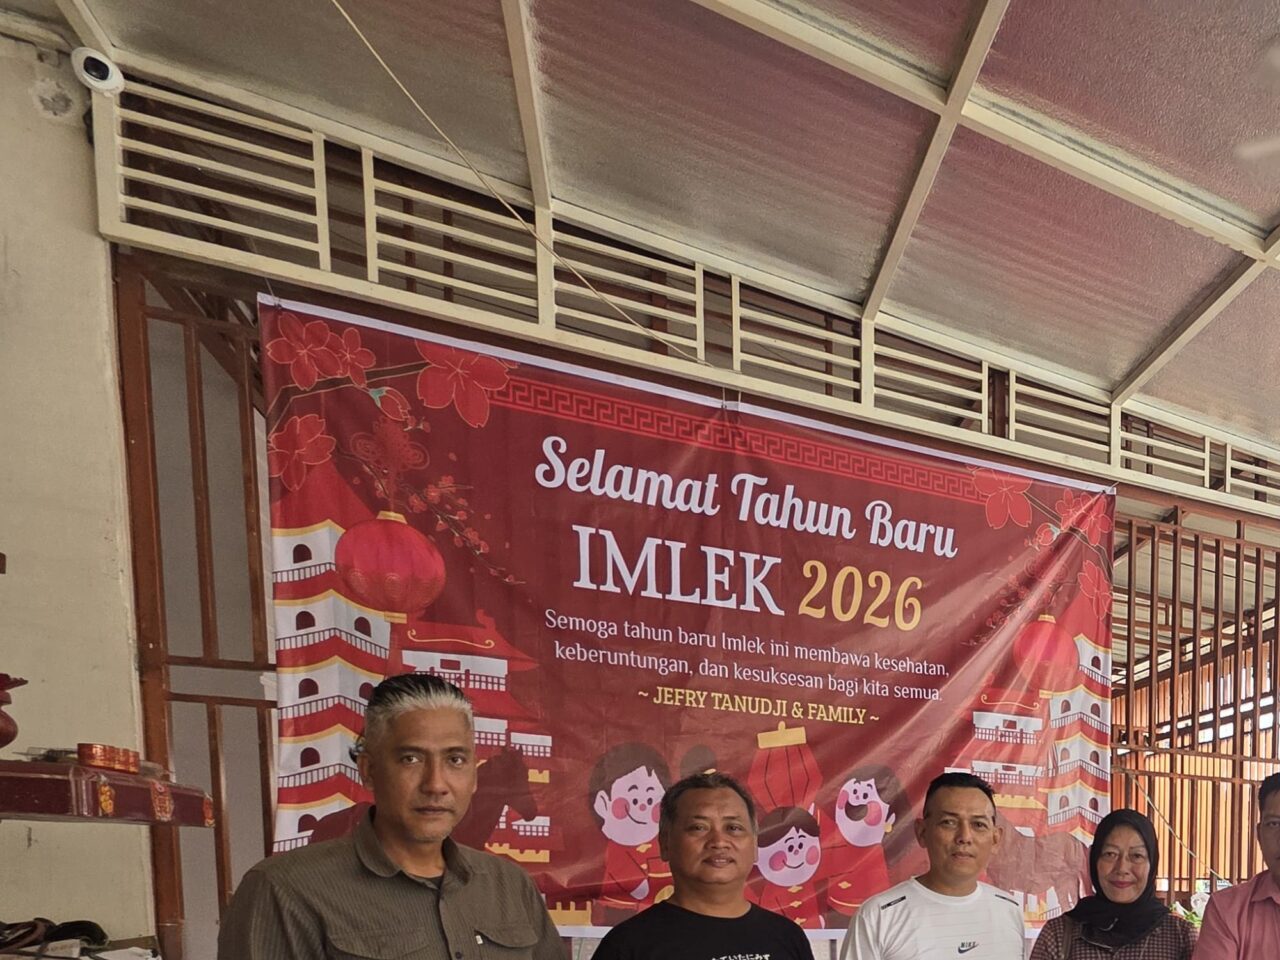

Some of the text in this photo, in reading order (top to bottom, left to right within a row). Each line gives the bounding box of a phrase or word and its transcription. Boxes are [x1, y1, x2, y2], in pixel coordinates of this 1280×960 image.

[535, 436, 958, 558] Selamat Tahun Baru
[572, 524, 924, 631] IMLEK 2026
[545, 609, 950, 678] Semoga tahun baru Imlek ini membawa kesehatan,
[554, 640, 942, 701] keberuntungan, dan kesuksesan bagi kita semua.
[652, 686, 707, 709] JEFRY
[711, 692, 788, 718] TANUDJI
[791, 701, 804, 718] &
[807, 703, 866, 724] FAMILY
